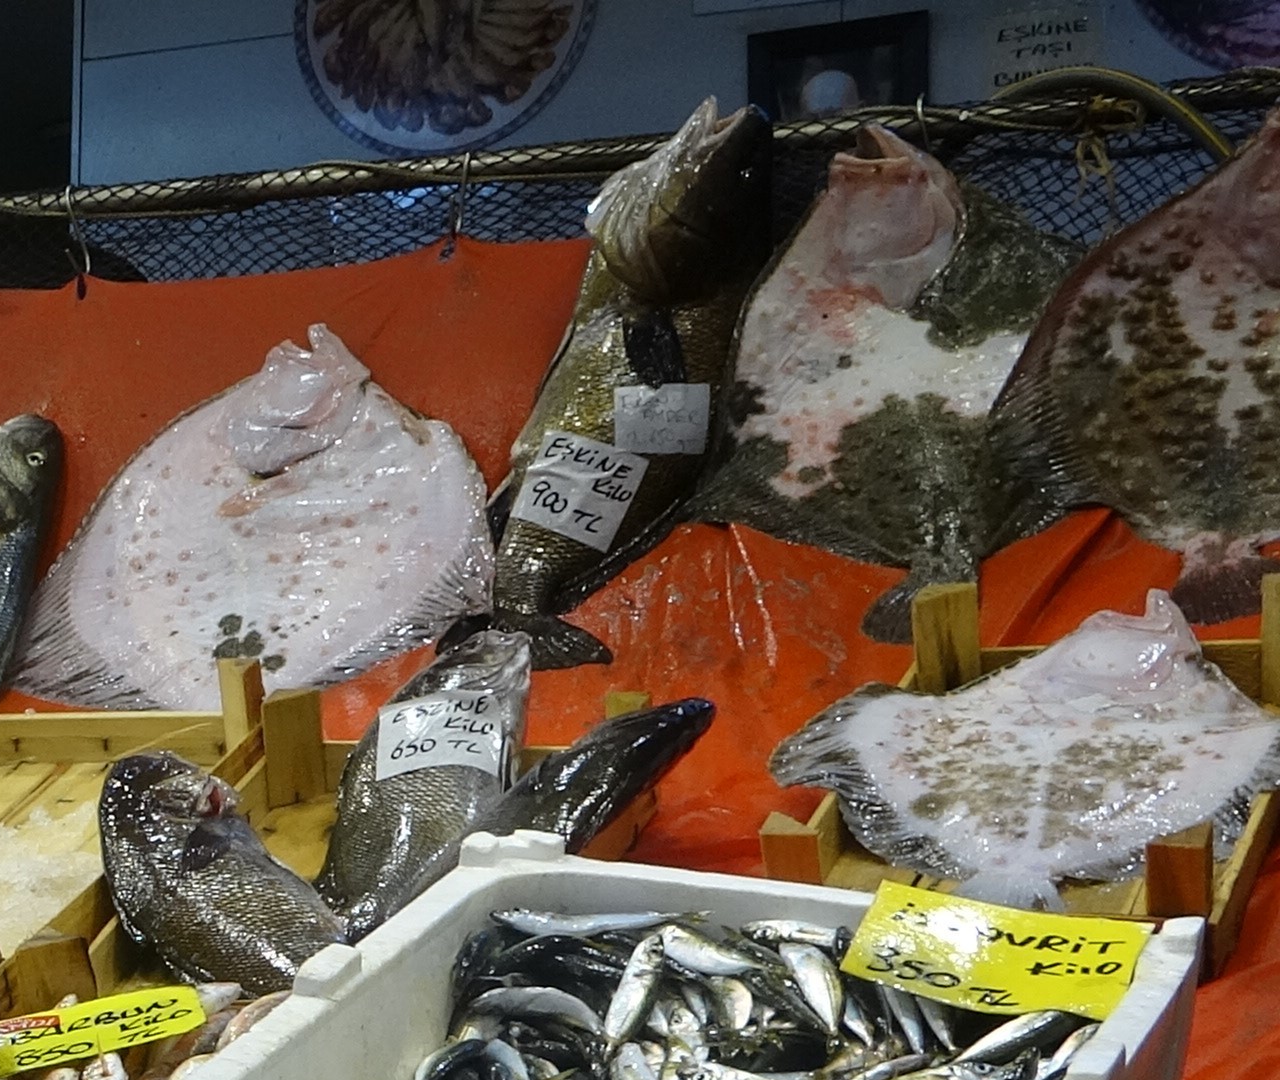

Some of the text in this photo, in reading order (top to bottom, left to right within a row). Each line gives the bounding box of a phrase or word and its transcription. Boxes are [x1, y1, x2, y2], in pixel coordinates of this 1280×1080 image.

[532, 480, 603, 534] 900 TL
[390, 736, 483, 760] 650 TL
[968, 986, 1020, 1006] TL
[9, 999, 178, 1046] BARBUN
[14, 1042, 94, 1066] 850
